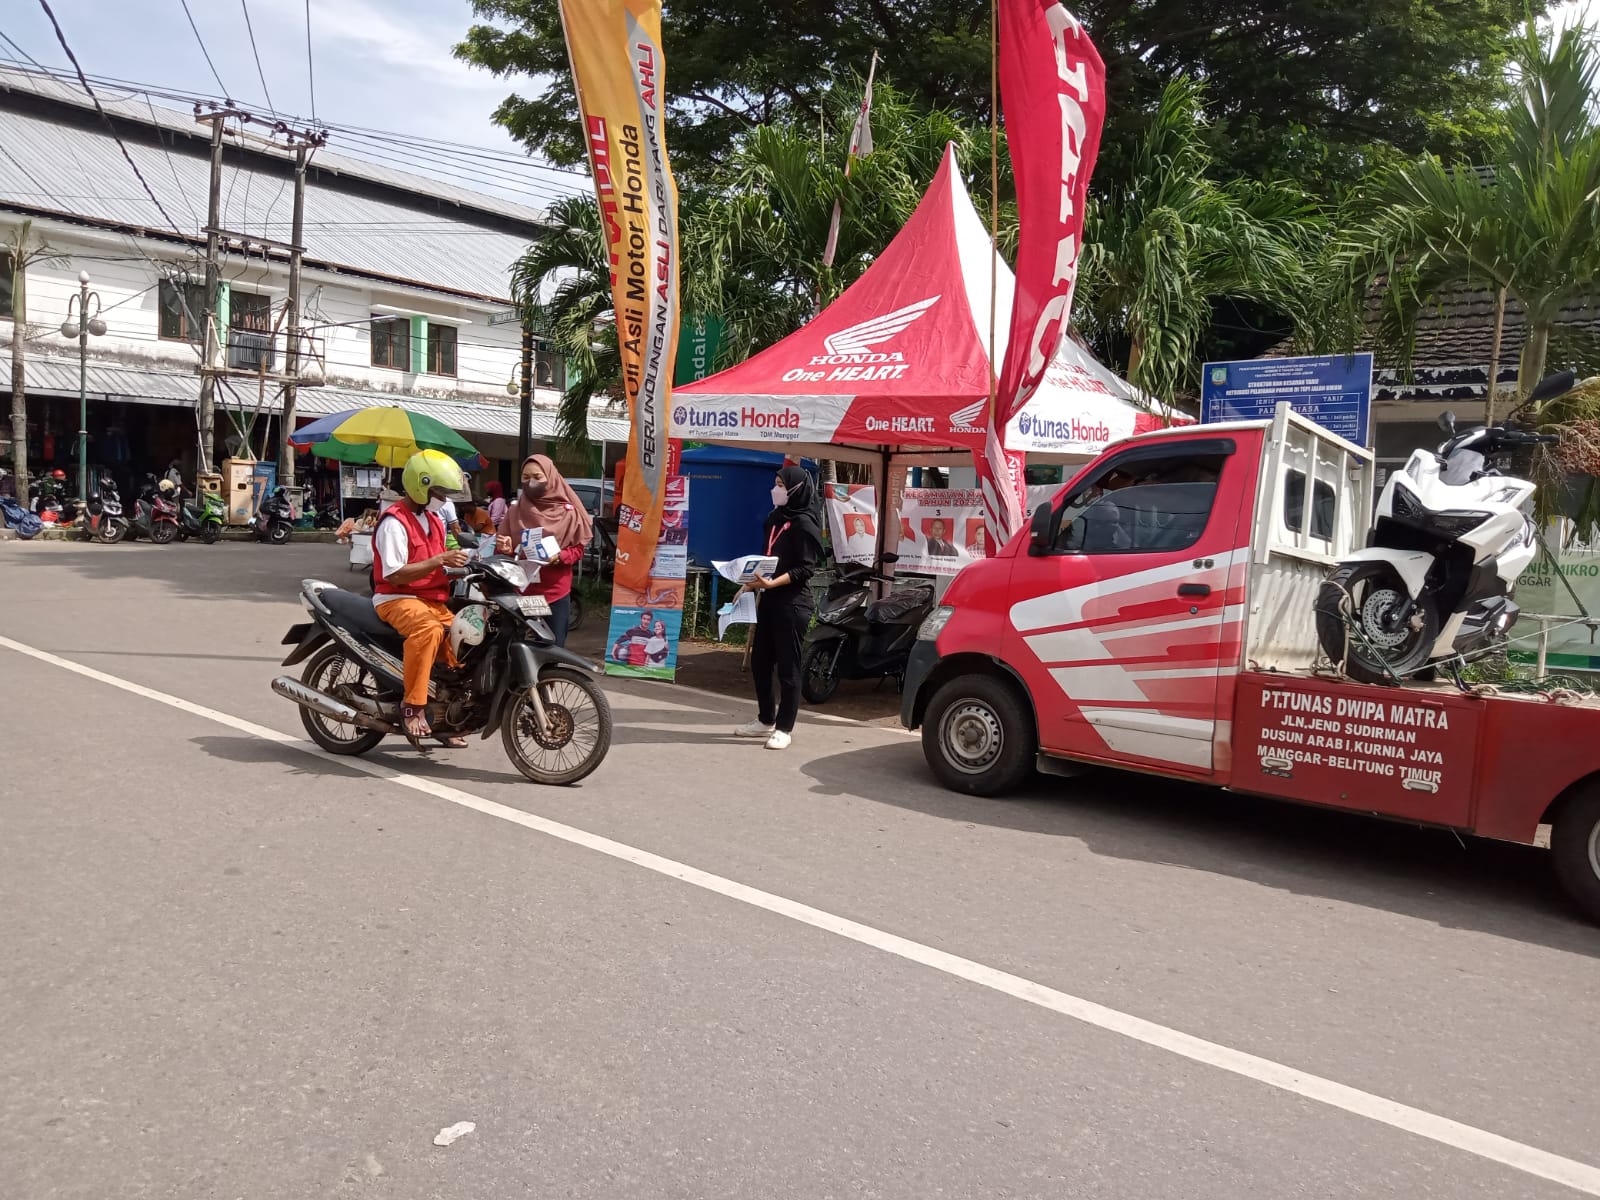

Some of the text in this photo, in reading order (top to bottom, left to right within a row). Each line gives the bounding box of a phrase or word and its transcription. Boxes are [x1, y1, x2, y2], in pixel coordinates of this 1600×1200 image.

[619, 124, 643, 214] Honda
[625, 221, 645, 303] Motor
[637, 43, 671, 470] PERLINDUNGAN ASLI DARI YANG AHLI
[624, 307, 644, 357] Asli
[808, 352, 905, 366] HONDA
[781, 364, 910, 382] One HEART.
[689, 406, 800, 429] tunas Honda
[1258, 407, 1276, 415] PAR
[865, 416, 935, 433] One HEART.
[949, 426, 987, 434] HONDA
[1032, 419, 1109, 443] tunas Honda
[904, 489, 983, 500] KECAMATAN MA
[918, 499, 951, 507] TAHUN
[936, 509, 942, 517] 3
[1523, 562, 1549, 575] NIS
[1261, 690, 1449, 730] PT.TUNAS DWIPA MATRA
[1281, 715, 1416, 744] JLN.JEND SUDIRMAN
[1261, 728, 1303, 744] DUSUN
[1307, 734, 1343, 750] ARAB
[1410, 749, 1444, 765] JAYA
[1399, 766, 1442, 784] TIMUR
